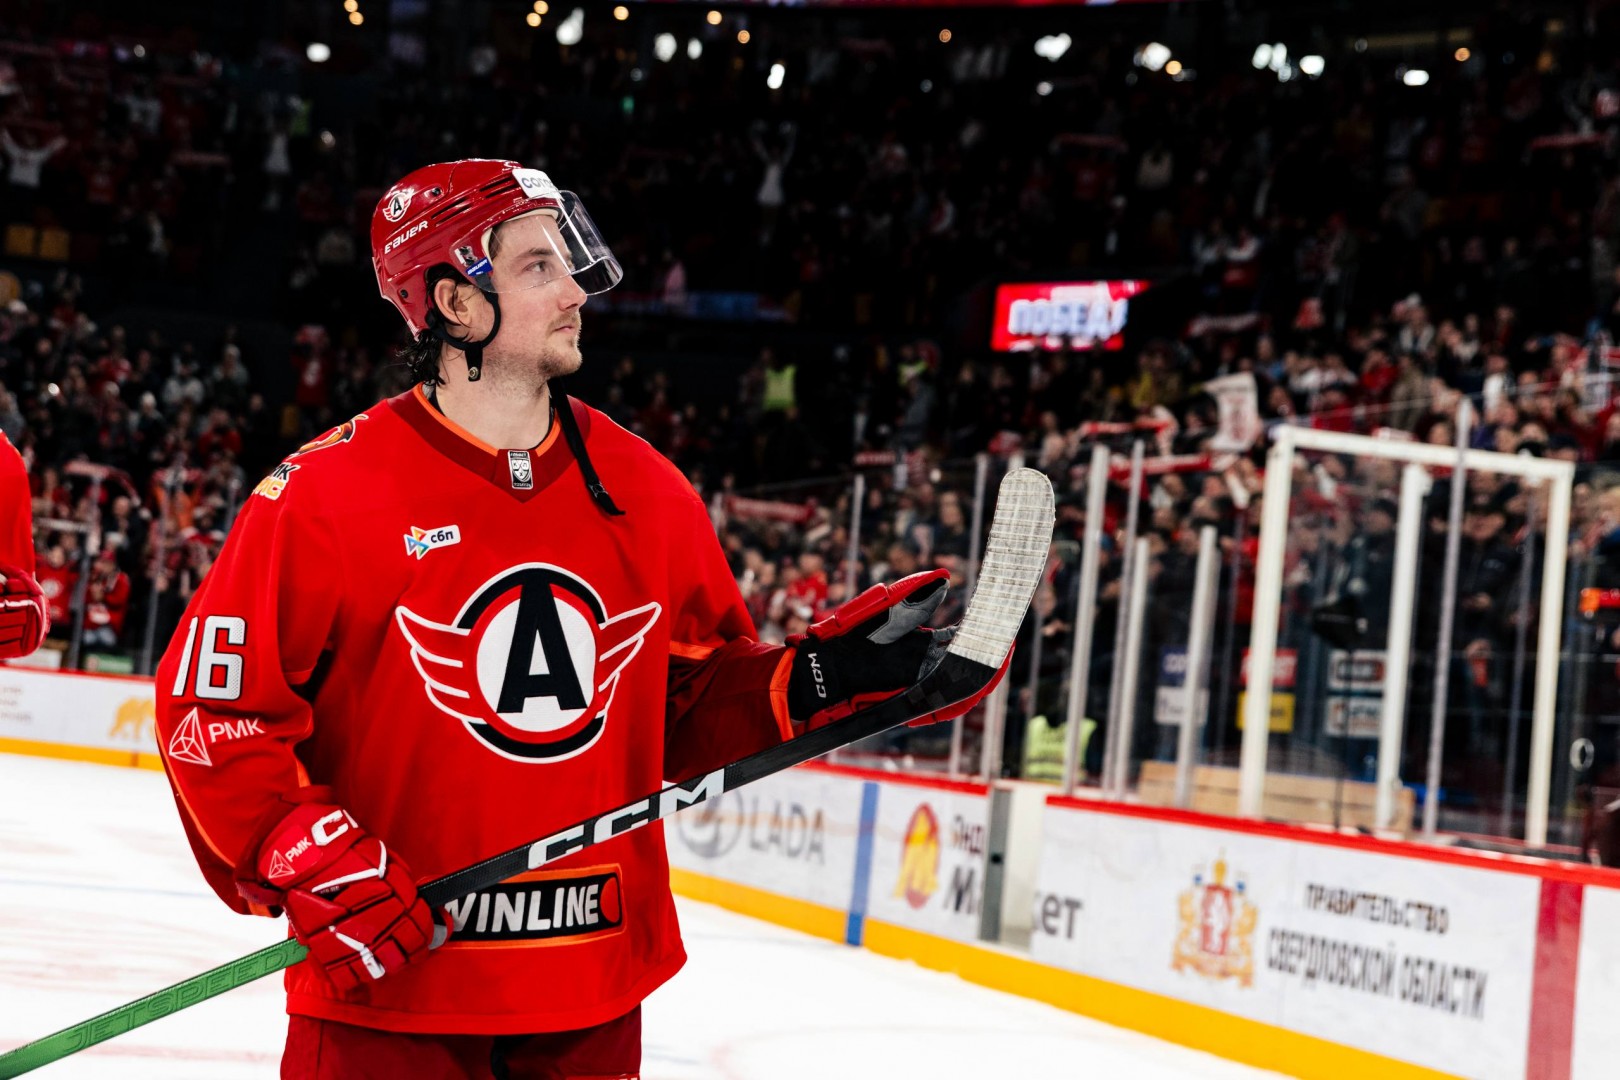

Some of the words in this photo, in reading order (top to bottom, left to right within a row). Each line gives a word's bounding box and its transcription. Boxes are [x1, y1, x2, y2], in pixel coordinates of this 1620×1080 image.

[384, 220, 428, 255] BAUER
[431, 530, 454, 543] сбп
[172, 615, 246, 700] 16
[807, 653, 827, 698] CCM
[527, 768, 725, 870] CCM
[749, 796, 825, 866] LADA
[1306, 883, 1450, 935] ПРАВИТЕЛЬСТВО
[64, 951, 289, 1051] JETSPEED
[1267, 927, 1397, 998] СВЕРДЛОВСКОЙ
[1400, 955, 1489, 1020] ОБЛАСТИ
